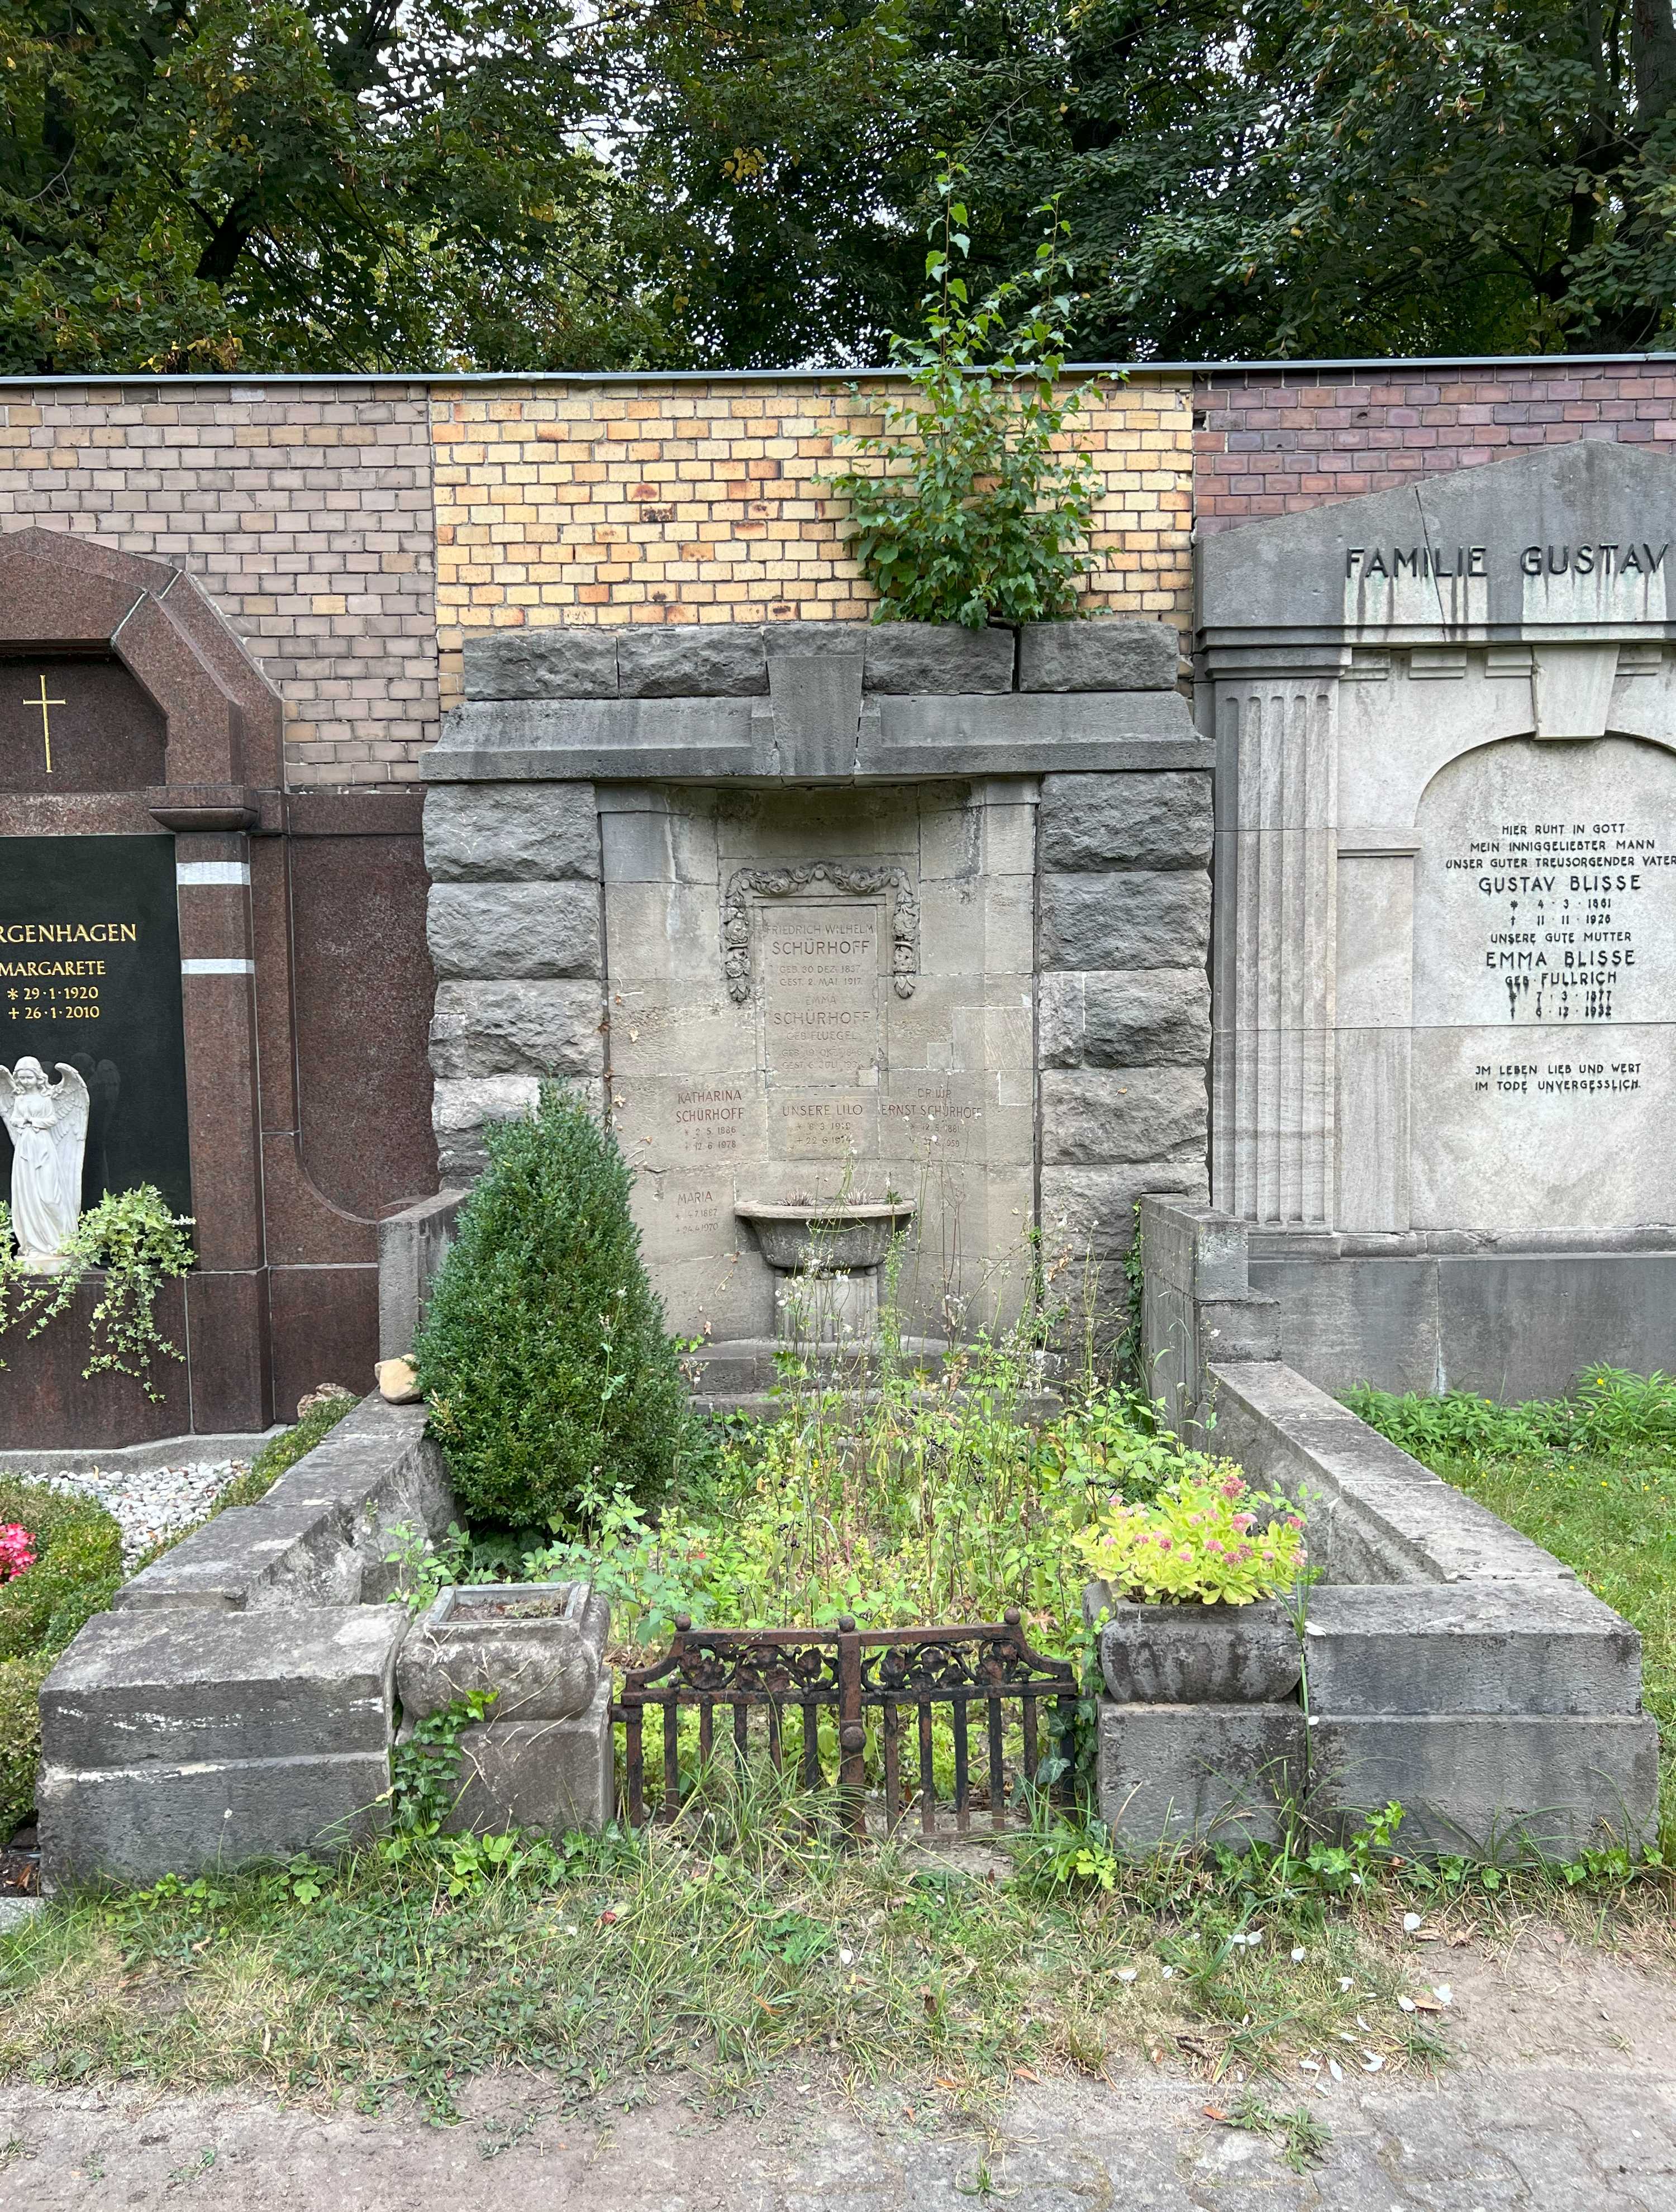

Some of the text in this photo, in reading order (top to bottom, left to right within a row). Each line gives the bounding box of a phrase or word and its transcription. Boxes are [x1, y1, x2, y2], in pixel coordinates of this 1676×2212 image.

[1346, 543, 1669, 578] FAMILIE GUSTAV
[1502, 824, 1625, 835] HIER RUHT IN GOTT
[1470, 840, 1654, 852] MEIN INNIGGELIEBTER MANN
[1446, 856, 1676, 869] UNSER GUTER TREUSORGENDER VATER
[1479, 874, 1641, 893] GUSTAV BLISSE
[767, 924, 874, 934] FRIEDRICH WILHELM
[1491, 932, 1631, 944] UNSERE GUTE MUTTER
[772, 939, 869, 954] SCHÜRHOFF
[1487, 950, 1635, 969] EMMA BLISSE
[0, 960, 106, 976] MARGARETE
[1541, 972, 1616, 987] FULLRICH
[806, 996, 836, 1005] EMMA
[774, 1009, 870, 1025] SCHÜRHOFF
[811, 1031, 856, 1040] FLUEGEL
[1499, 1065, 1537, 1075] LEBEN
[1549, 1065, 1571, 1074] LIEB
[1579, 1064, 1603, 1073] UND
[1612, 1063, 1641, 1073] WERT
[1475, 1082, 1488, 1091] IM
[1497, 1081, 1527, 1092] TODE
[678, 1090, 742, 1104] KATHARINA
[783, 1104, 863, 1116] UNSERE LILO
[882, 1105, 916, 1116] ERNST
[678, 1191, 713, 1205] MARIA
